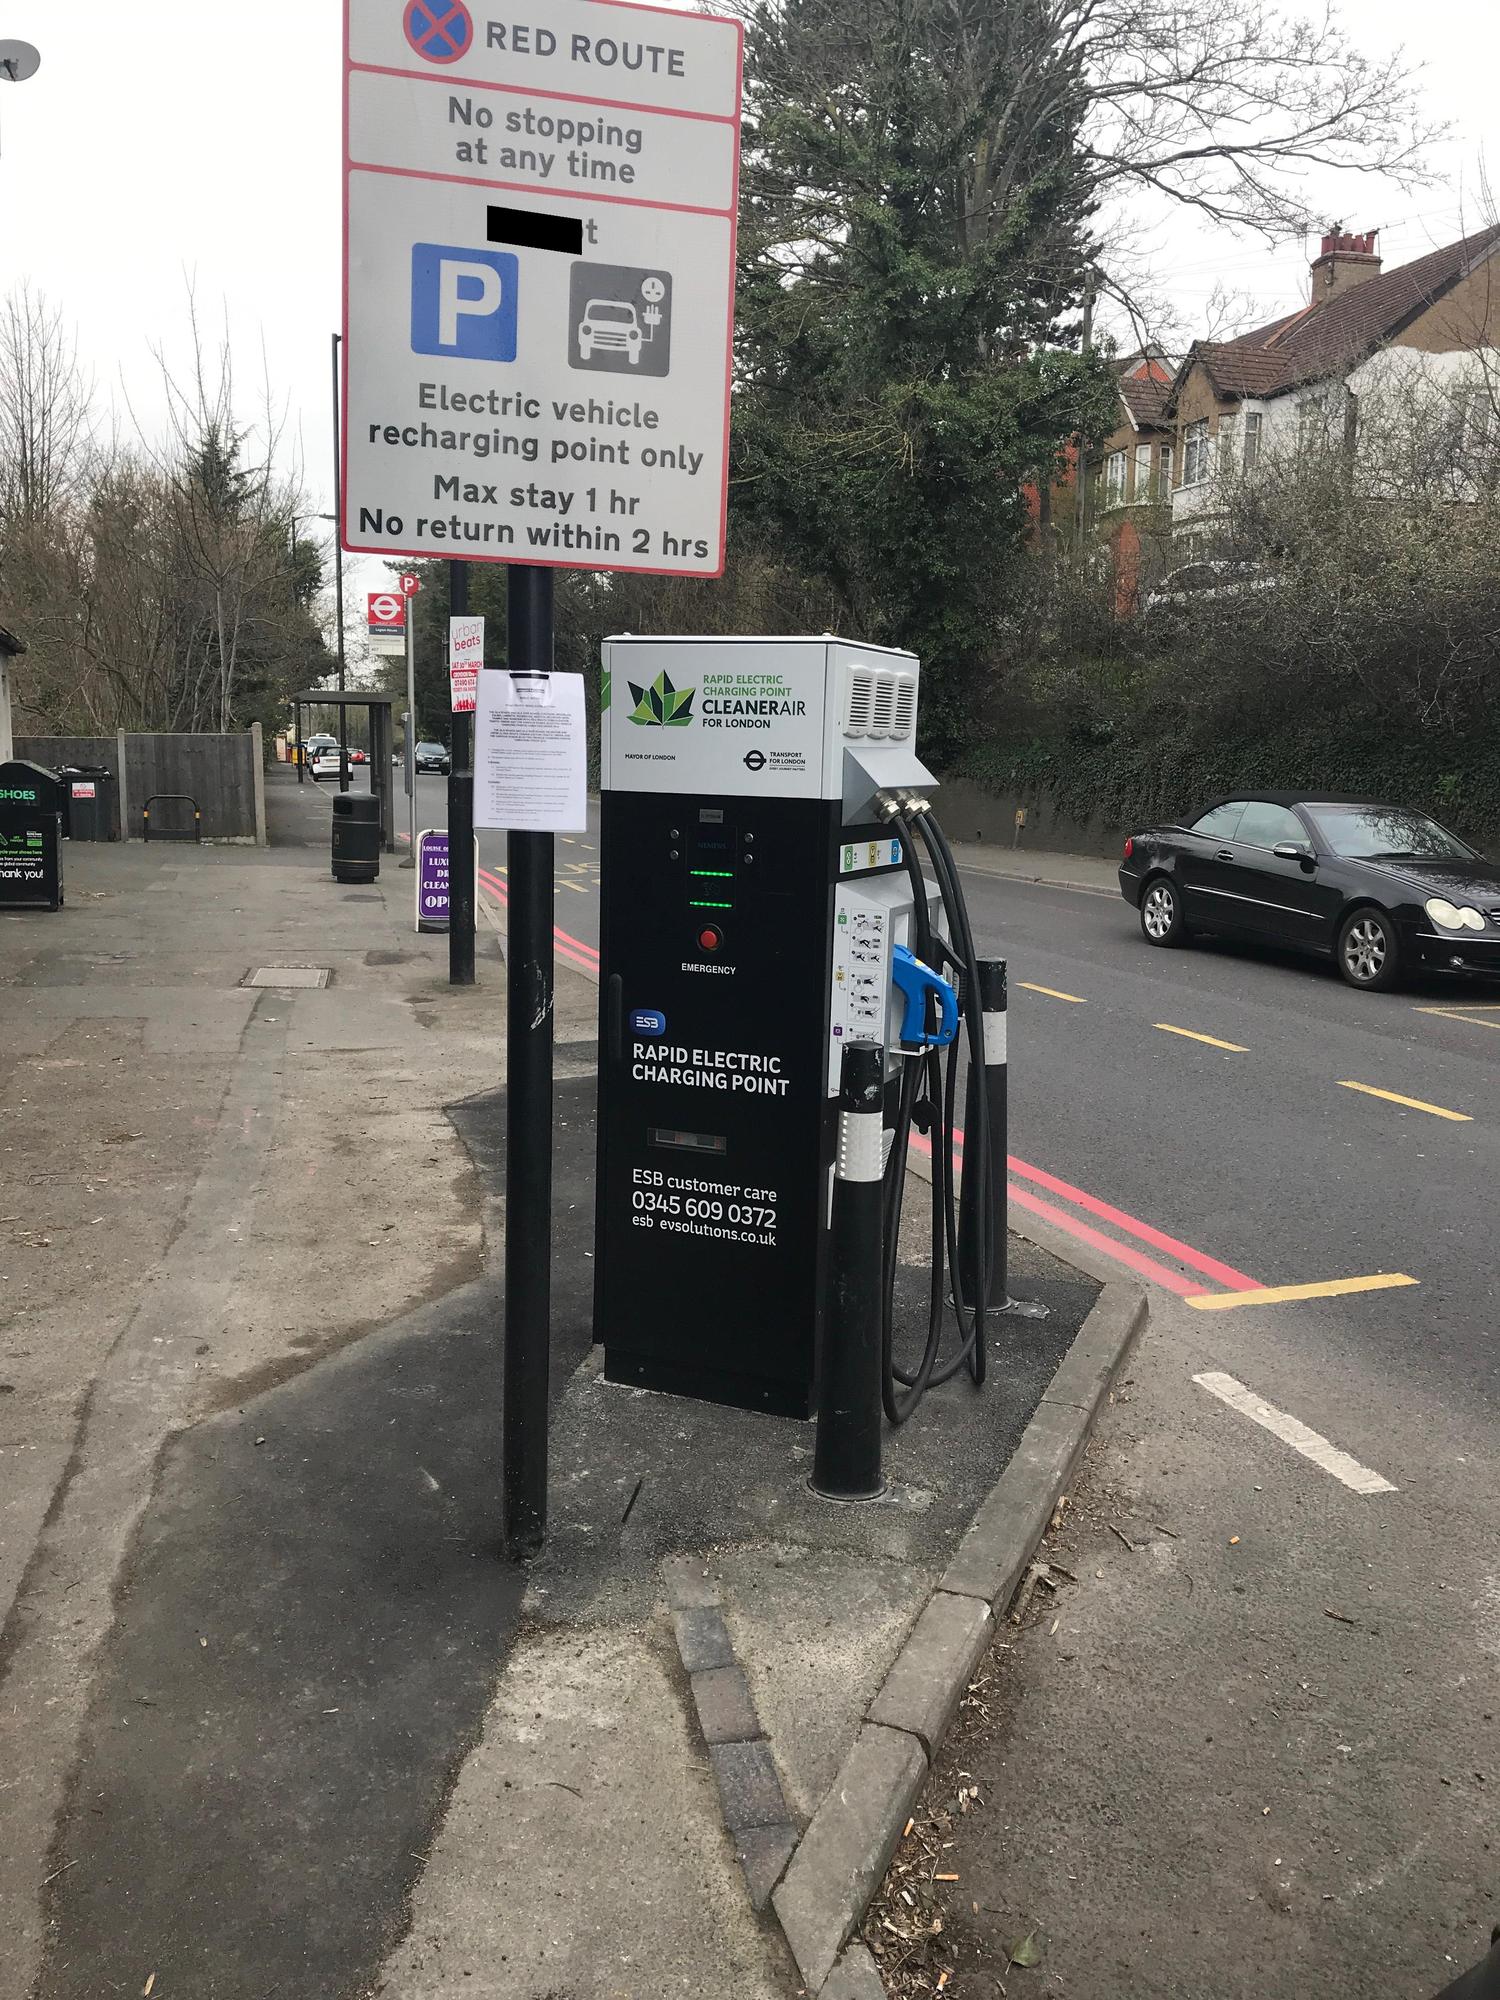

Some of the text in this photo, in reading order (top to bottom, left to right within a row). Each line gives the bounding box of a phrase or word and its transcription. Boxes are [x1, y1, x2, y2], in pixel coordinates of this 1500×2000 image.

[487, 21, 685, 77] RED ROUTE
[449, 96, 642, 153] No stopping
[456, 137, 636, 184] at any time
[439, 259, 501, 345] P
[419, 382, 659, 429] Electric vehicle
[369, 423, 704, 475] recharging point only
[434, 475, 640, 515] Max stay 1 hr
[360, 508, 709, 558] No return within 2 hrs
[404, 577, 414, 591] P
[452, 622, 483, 640] urban
[455, 635, 480, 651] beats
[703, 674, 783, 685] RAPID ELECTRIC
[703, 686, 792, 697] CHARGING POINT
[702, 699, 806, 716] CLEANERAIR
[702, 718, 771, 729] FOR LONDON
[0, 789, 36, 800] SHOES
[429, 858, 449, 866] LUX
[0, 868, 44, 881] hank you!
[681, 963, 736, 975] EMERGENCY
[636, 1016, 659, 1029] ESB
[633, 1043, 781, 1074] RAPID ELECTRIC
[632, 1064, 790, 1096] CHARGING POINT
[632, 1169, 777, 1202] ESB customer care
[632, 1191, 777, 1229] 0345 609 0372
